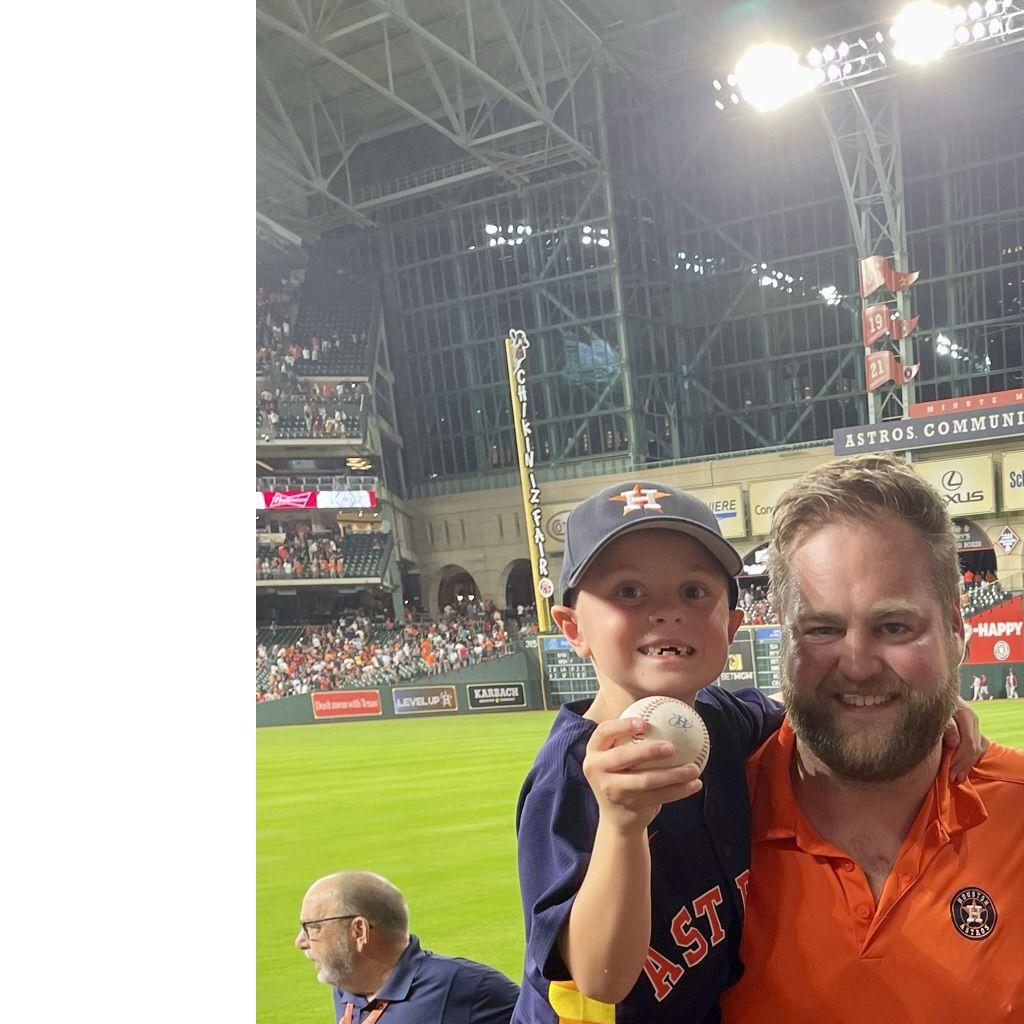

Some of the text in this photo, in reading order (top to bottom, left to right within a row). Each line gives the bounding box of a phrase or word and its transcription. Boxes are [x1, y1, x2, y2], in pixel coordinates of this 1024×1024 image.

[869, 313, 883, 334] 19
[870, 359, 884, 378] 21
[516, 368, 535, 469] CHIKIN
[529, 471, 541, 504] IZ
[943, 490, 984, 504] XUS
[531, 508, 549, 577] FAIR
[720, 671, 753, 681] BETMGM
[396, 695, 441, 707] LEVEL UP
[473, 687, 519, 699] KARBACH
[959, 923, 990, 937] ASTROS
